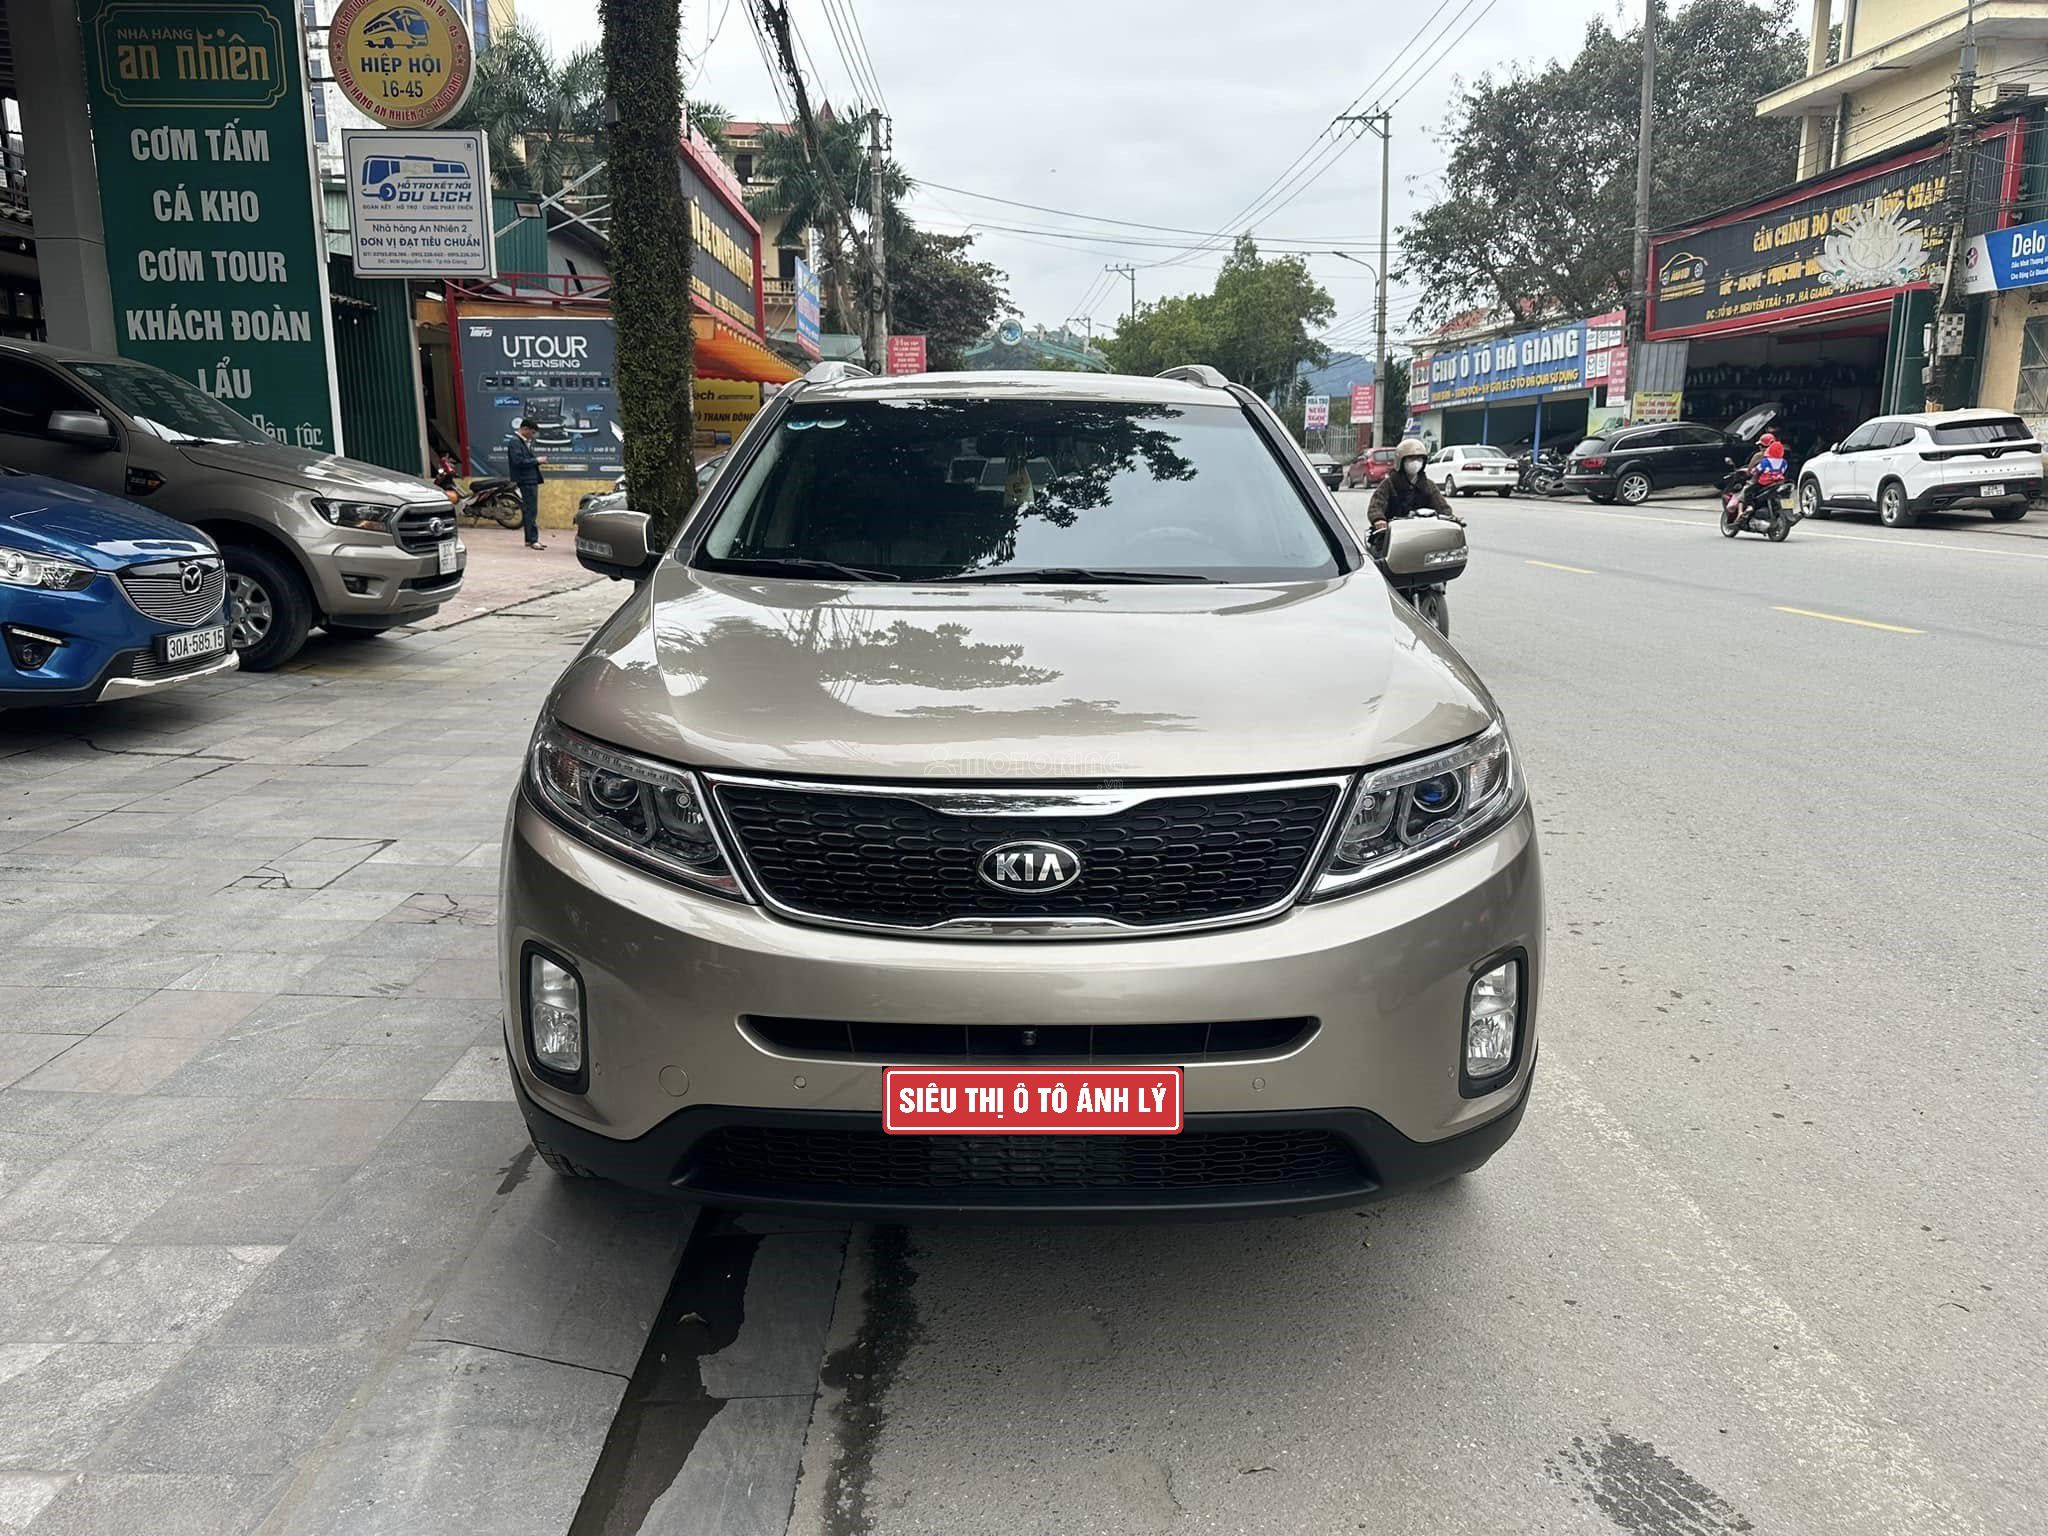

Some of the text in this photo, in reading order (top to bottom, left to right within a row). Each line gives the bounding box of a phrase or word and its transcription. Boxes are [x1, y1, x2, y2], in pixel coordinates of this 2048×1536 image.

[117, 28, 270, 81] an nhiên
[361, 53, 442, 76] HIỆP HỘI
[382, 80, 424, 97] 16-45
[374, 104, 387, 117] AN
[130, 117, 270, 162] CƠM TẤM
[153, 183, 260, 222] CÁ KHO
[360, 237, 384, 247] ĐƠN
[386, 237, 397, 249] VỊ
[399, 237, 419, 249] ĐẠT
[444, 233, 481, 247] CHUẨN
[418, 225, 432, 233] An
[462, 225, 468, 233] 2
[2011, 230, 2046, 258] Delo
[138, 247, 287, 283] CƠM TOUR
[126, 303, 312, 342] KHÁCH ĐOÀN
[502, 335, 588, 358] UTOUR
[1432, 356, 1458, 386] CHỢ
[1460, 350, 1470, 377] Ô
[1473, 344, 1491, 375] TÔ
[1496, 338, 1518, 371] HÀ
[1522, 329, 1580, 366] GIANG
[512, 358, 581, 368] i-SENSING
[198, 356, 252, 399] LẨU
[704, 412, 730, 421] THANH
[169, 629, 224, 659] 30A-585.15
[995, 852, 1065, 881] KIA
